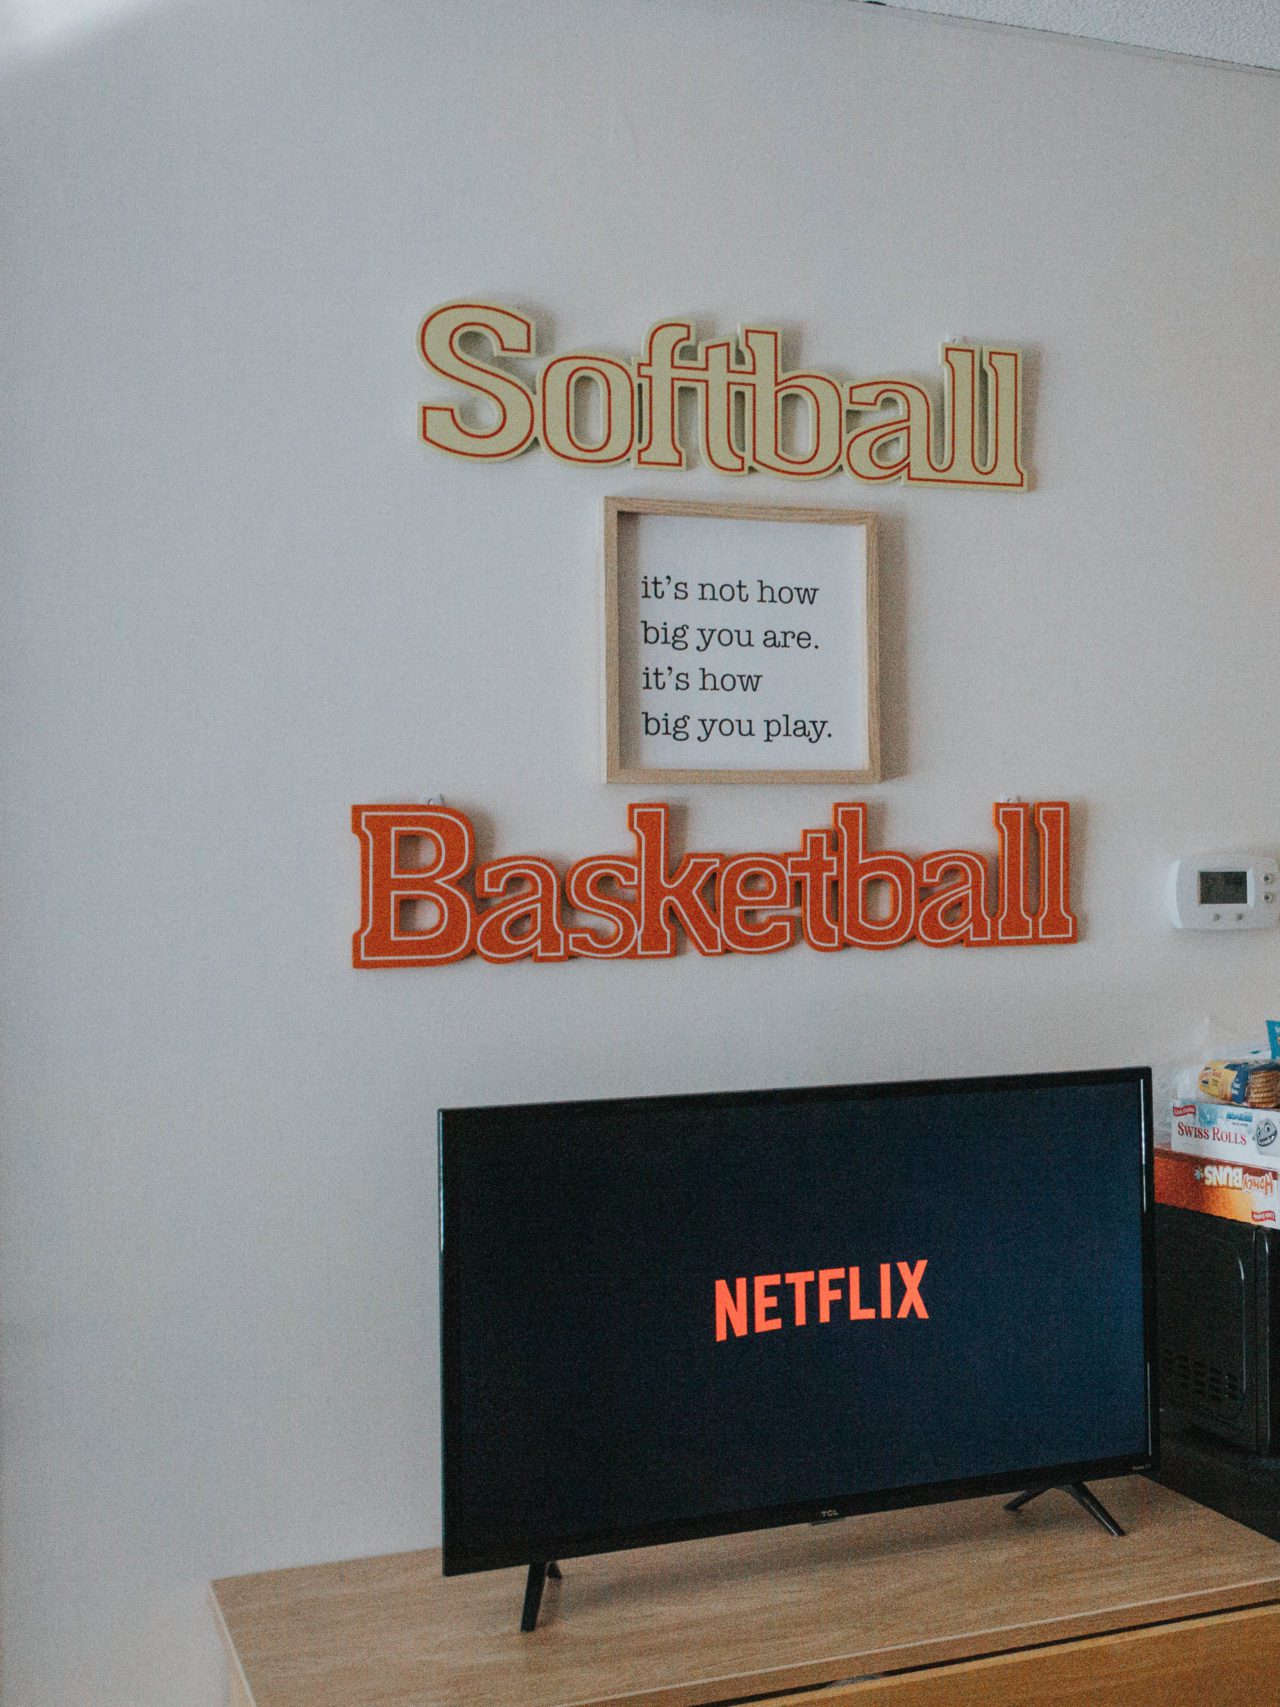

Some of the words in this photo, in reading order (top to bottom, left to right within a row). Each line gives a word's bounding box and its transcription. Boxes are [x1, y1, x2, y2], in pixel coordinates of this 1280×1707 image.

[417, 300, 1029, 490] Softball
[697, 579, 749, 603] not
[757, 579, 820, 605] how
[640, 620, 690, 651] big
[695, 627, 755, 653] you
[762, 629, 819, 650] are.
[698, 667, 763, 693] how
[640, 711, 691, 742] big
[696, 718, 756, 743] you
[763, 713, 832, 744] play.
[351, 801, 1078, 969] Basketball
[1203, 1164, 1243, 1189] BUNS
[714, 1259, 930, 1343] NETFLIX
[820, 1509, 839, 1518] TCL
